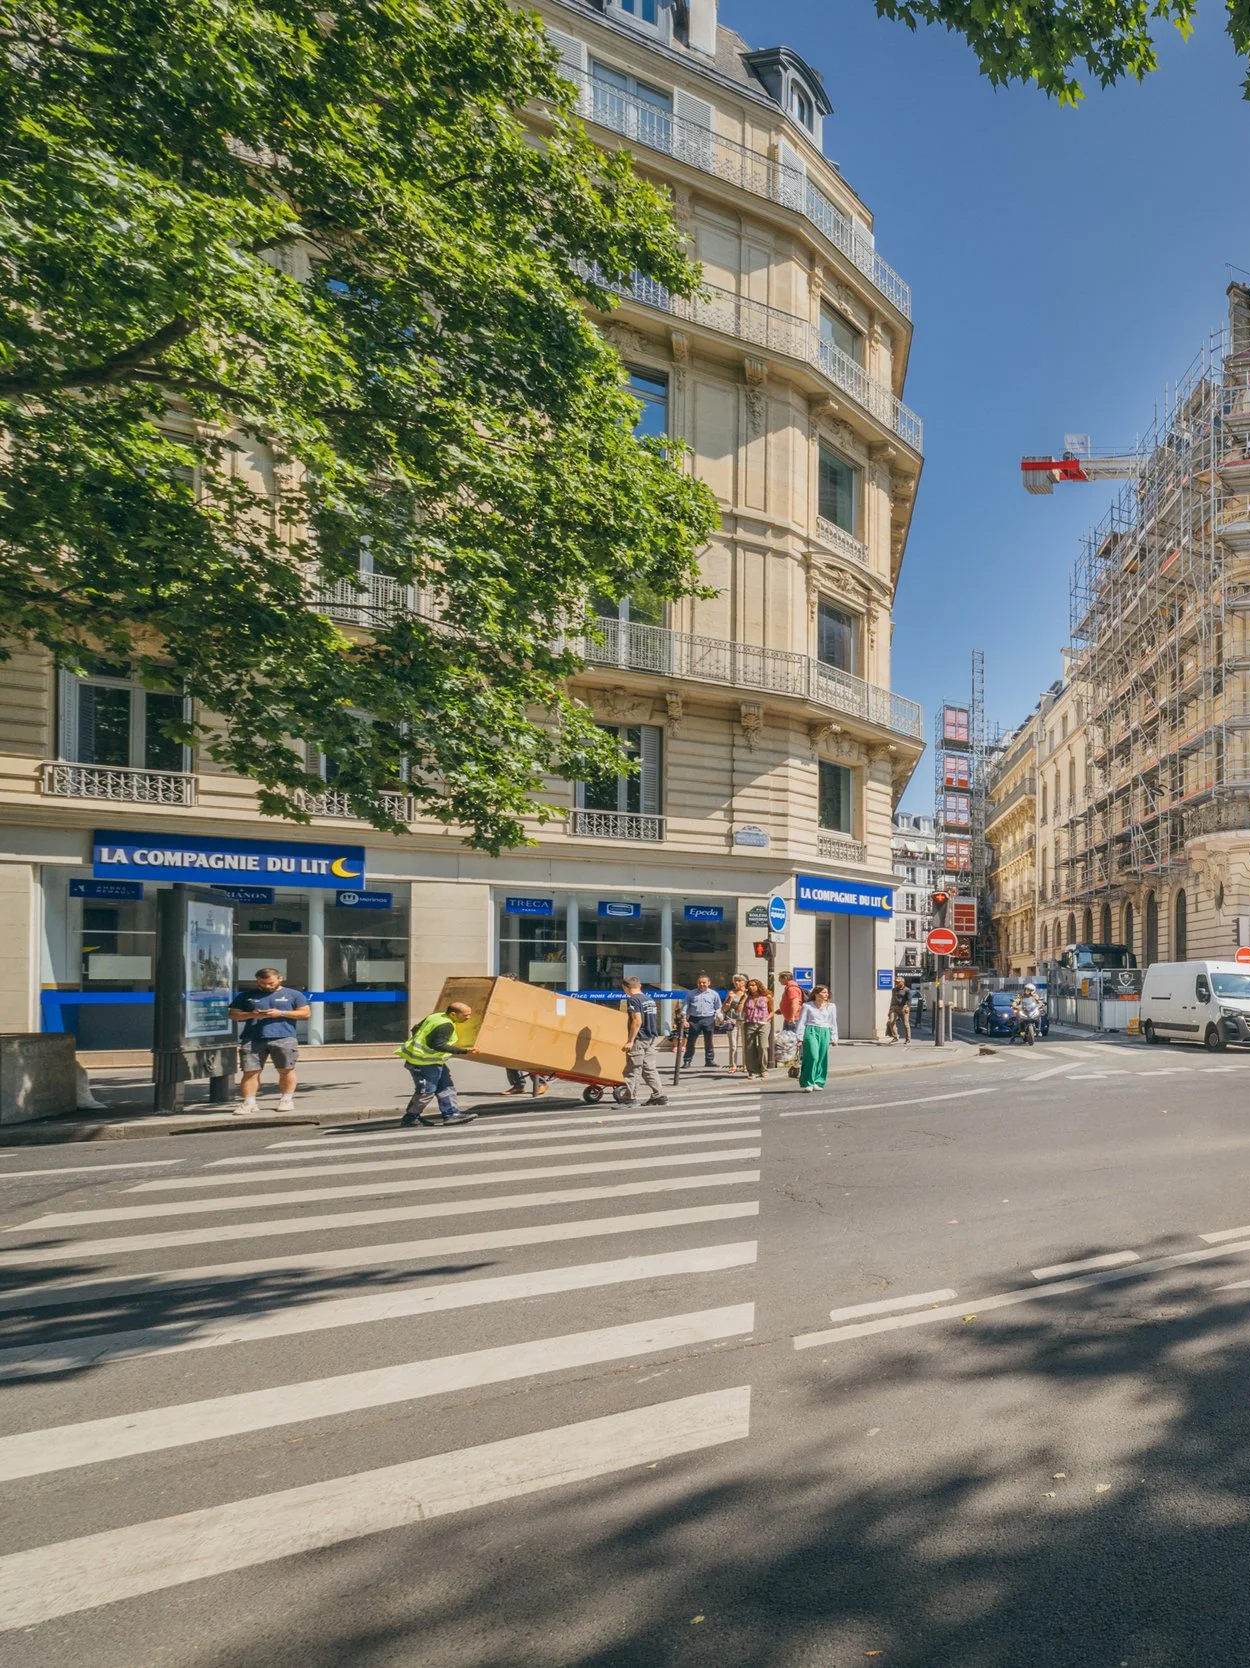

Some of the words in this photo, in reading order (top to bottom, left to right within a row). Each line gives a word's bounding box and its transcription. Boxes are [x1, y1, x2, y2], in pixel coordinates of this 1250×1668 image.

[100, 847, 128, 864] LA
[133, 849, 260, 871] COMPAGNIE
[267, 857, 296, 872] DU
[300, 858, 329, 874] LIT
[508, 899, 549, 908] TRECA
[800, 887, 811, 899] LA
[812, 889, 857, 905] COMPAGNIE
[859, 894, 870, 906] DU
[871, 896, 882, 907] LIT
[689, 907, 718, 918] Epeda
